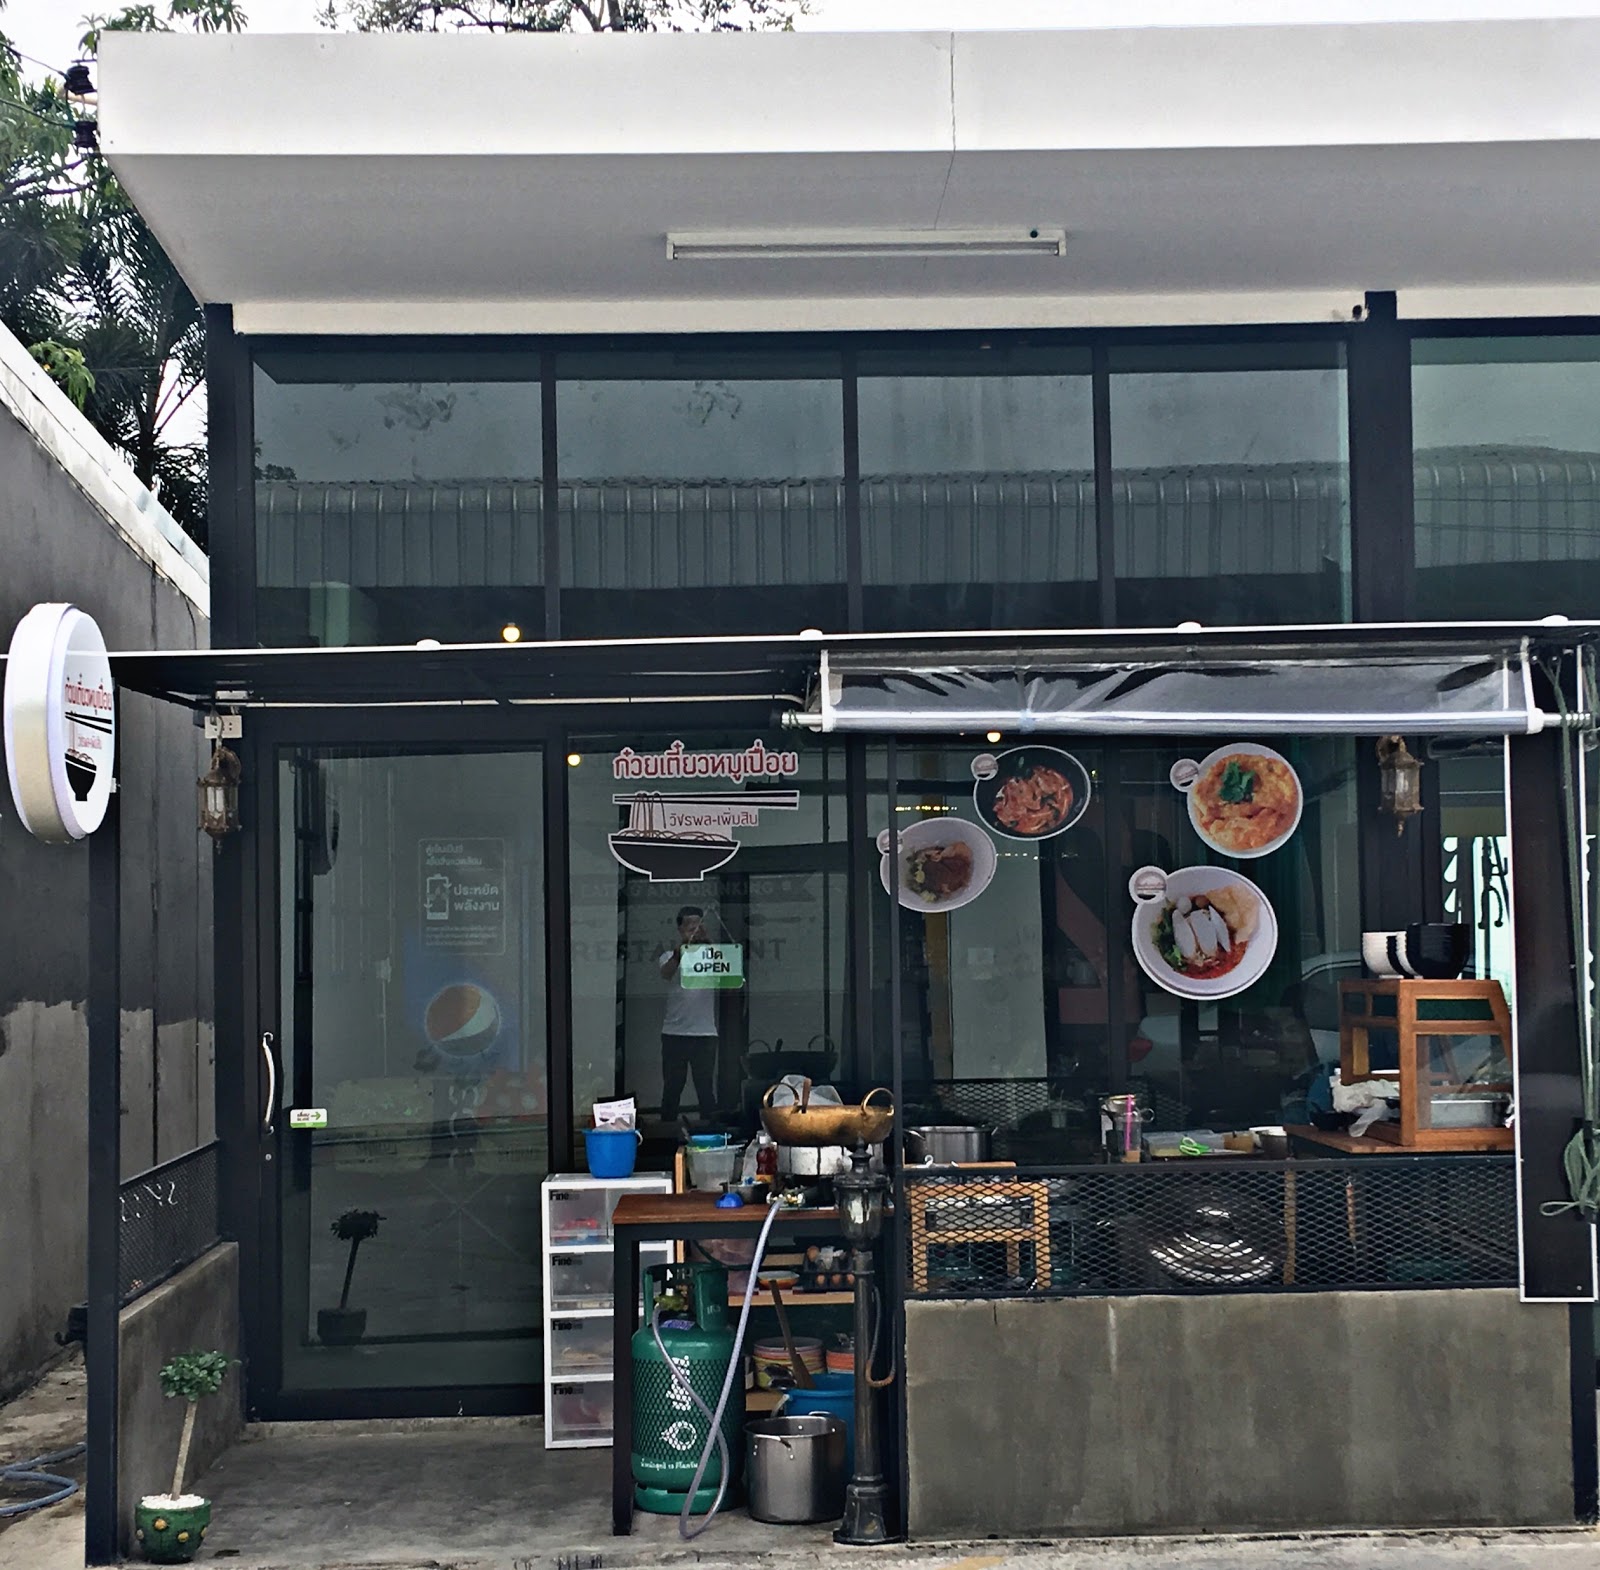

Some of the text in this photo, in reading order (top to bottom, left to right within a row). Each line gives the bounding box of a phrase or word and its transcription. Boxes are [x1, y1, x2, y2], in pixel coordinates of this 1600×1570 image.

[613, 740, 797, 783] ก๋วยเตี๋ยวหมูเปื่อย
[453, 883, 499, 896] ประหยัด
[453, 899, 500, 911] พลังงาน
[702, 947, 723, 960] เปิด
[693, 962, 730, 973] OPEN
